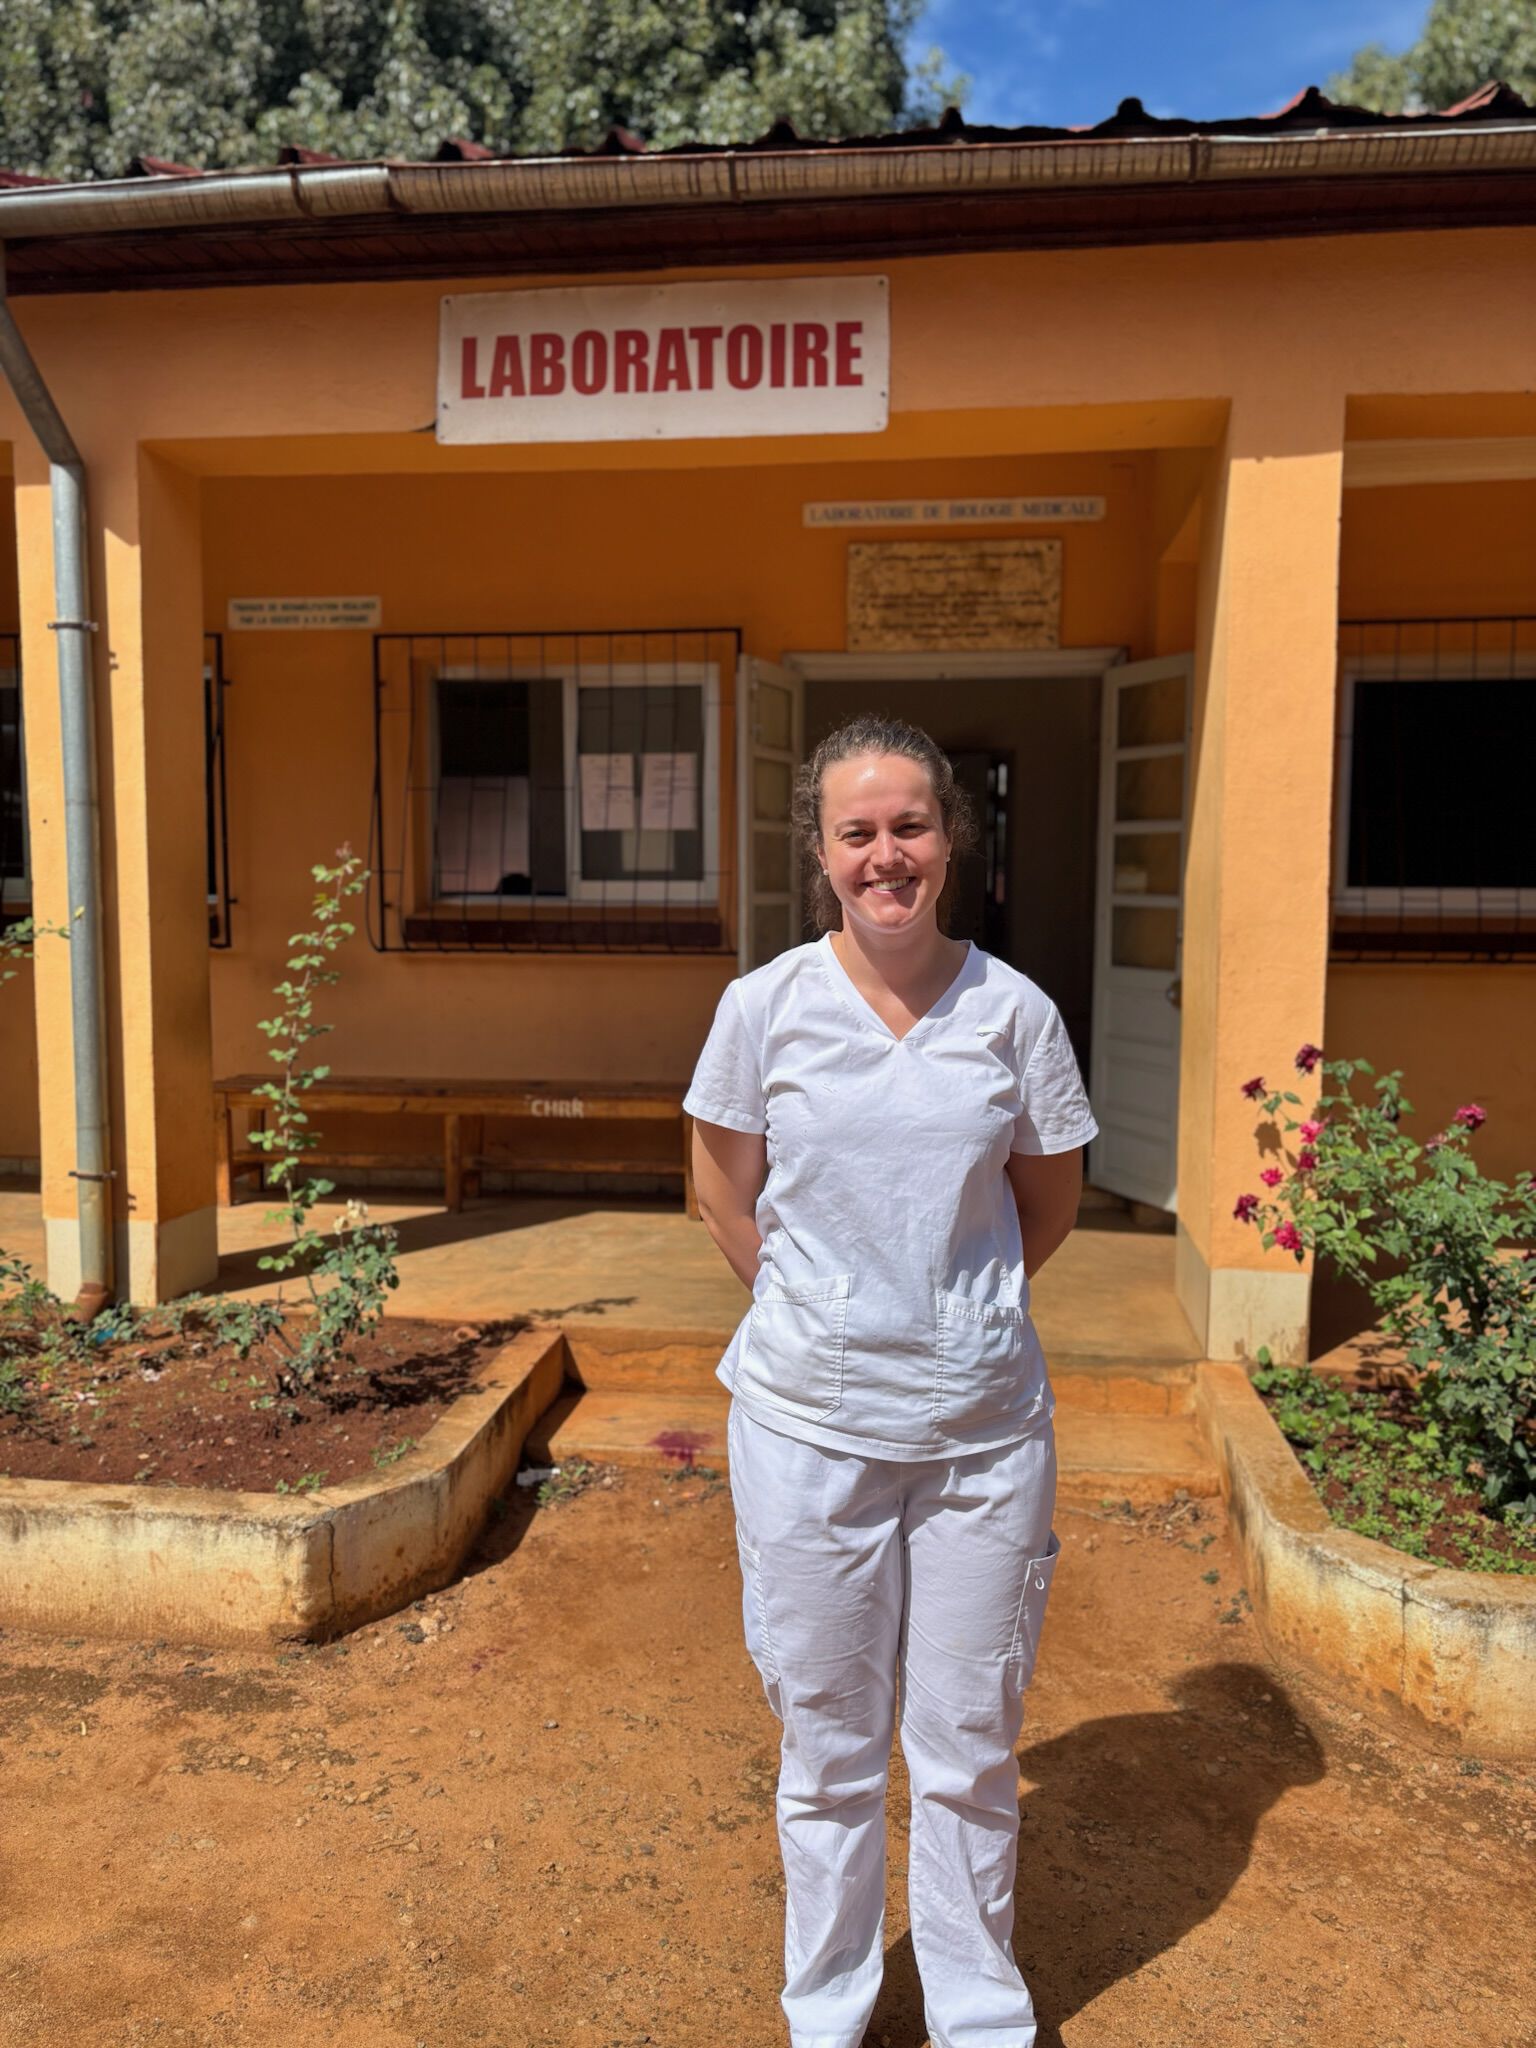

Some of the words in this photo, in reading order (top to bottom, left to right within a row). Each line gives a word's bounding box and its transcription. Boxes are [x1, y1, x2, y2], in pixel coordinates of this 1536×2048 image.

[461, 321, 864, 399] LABORATOIRE
[809, 505, 915, 522] LABORATOIRE
[922, 504, 941, 519] DE
